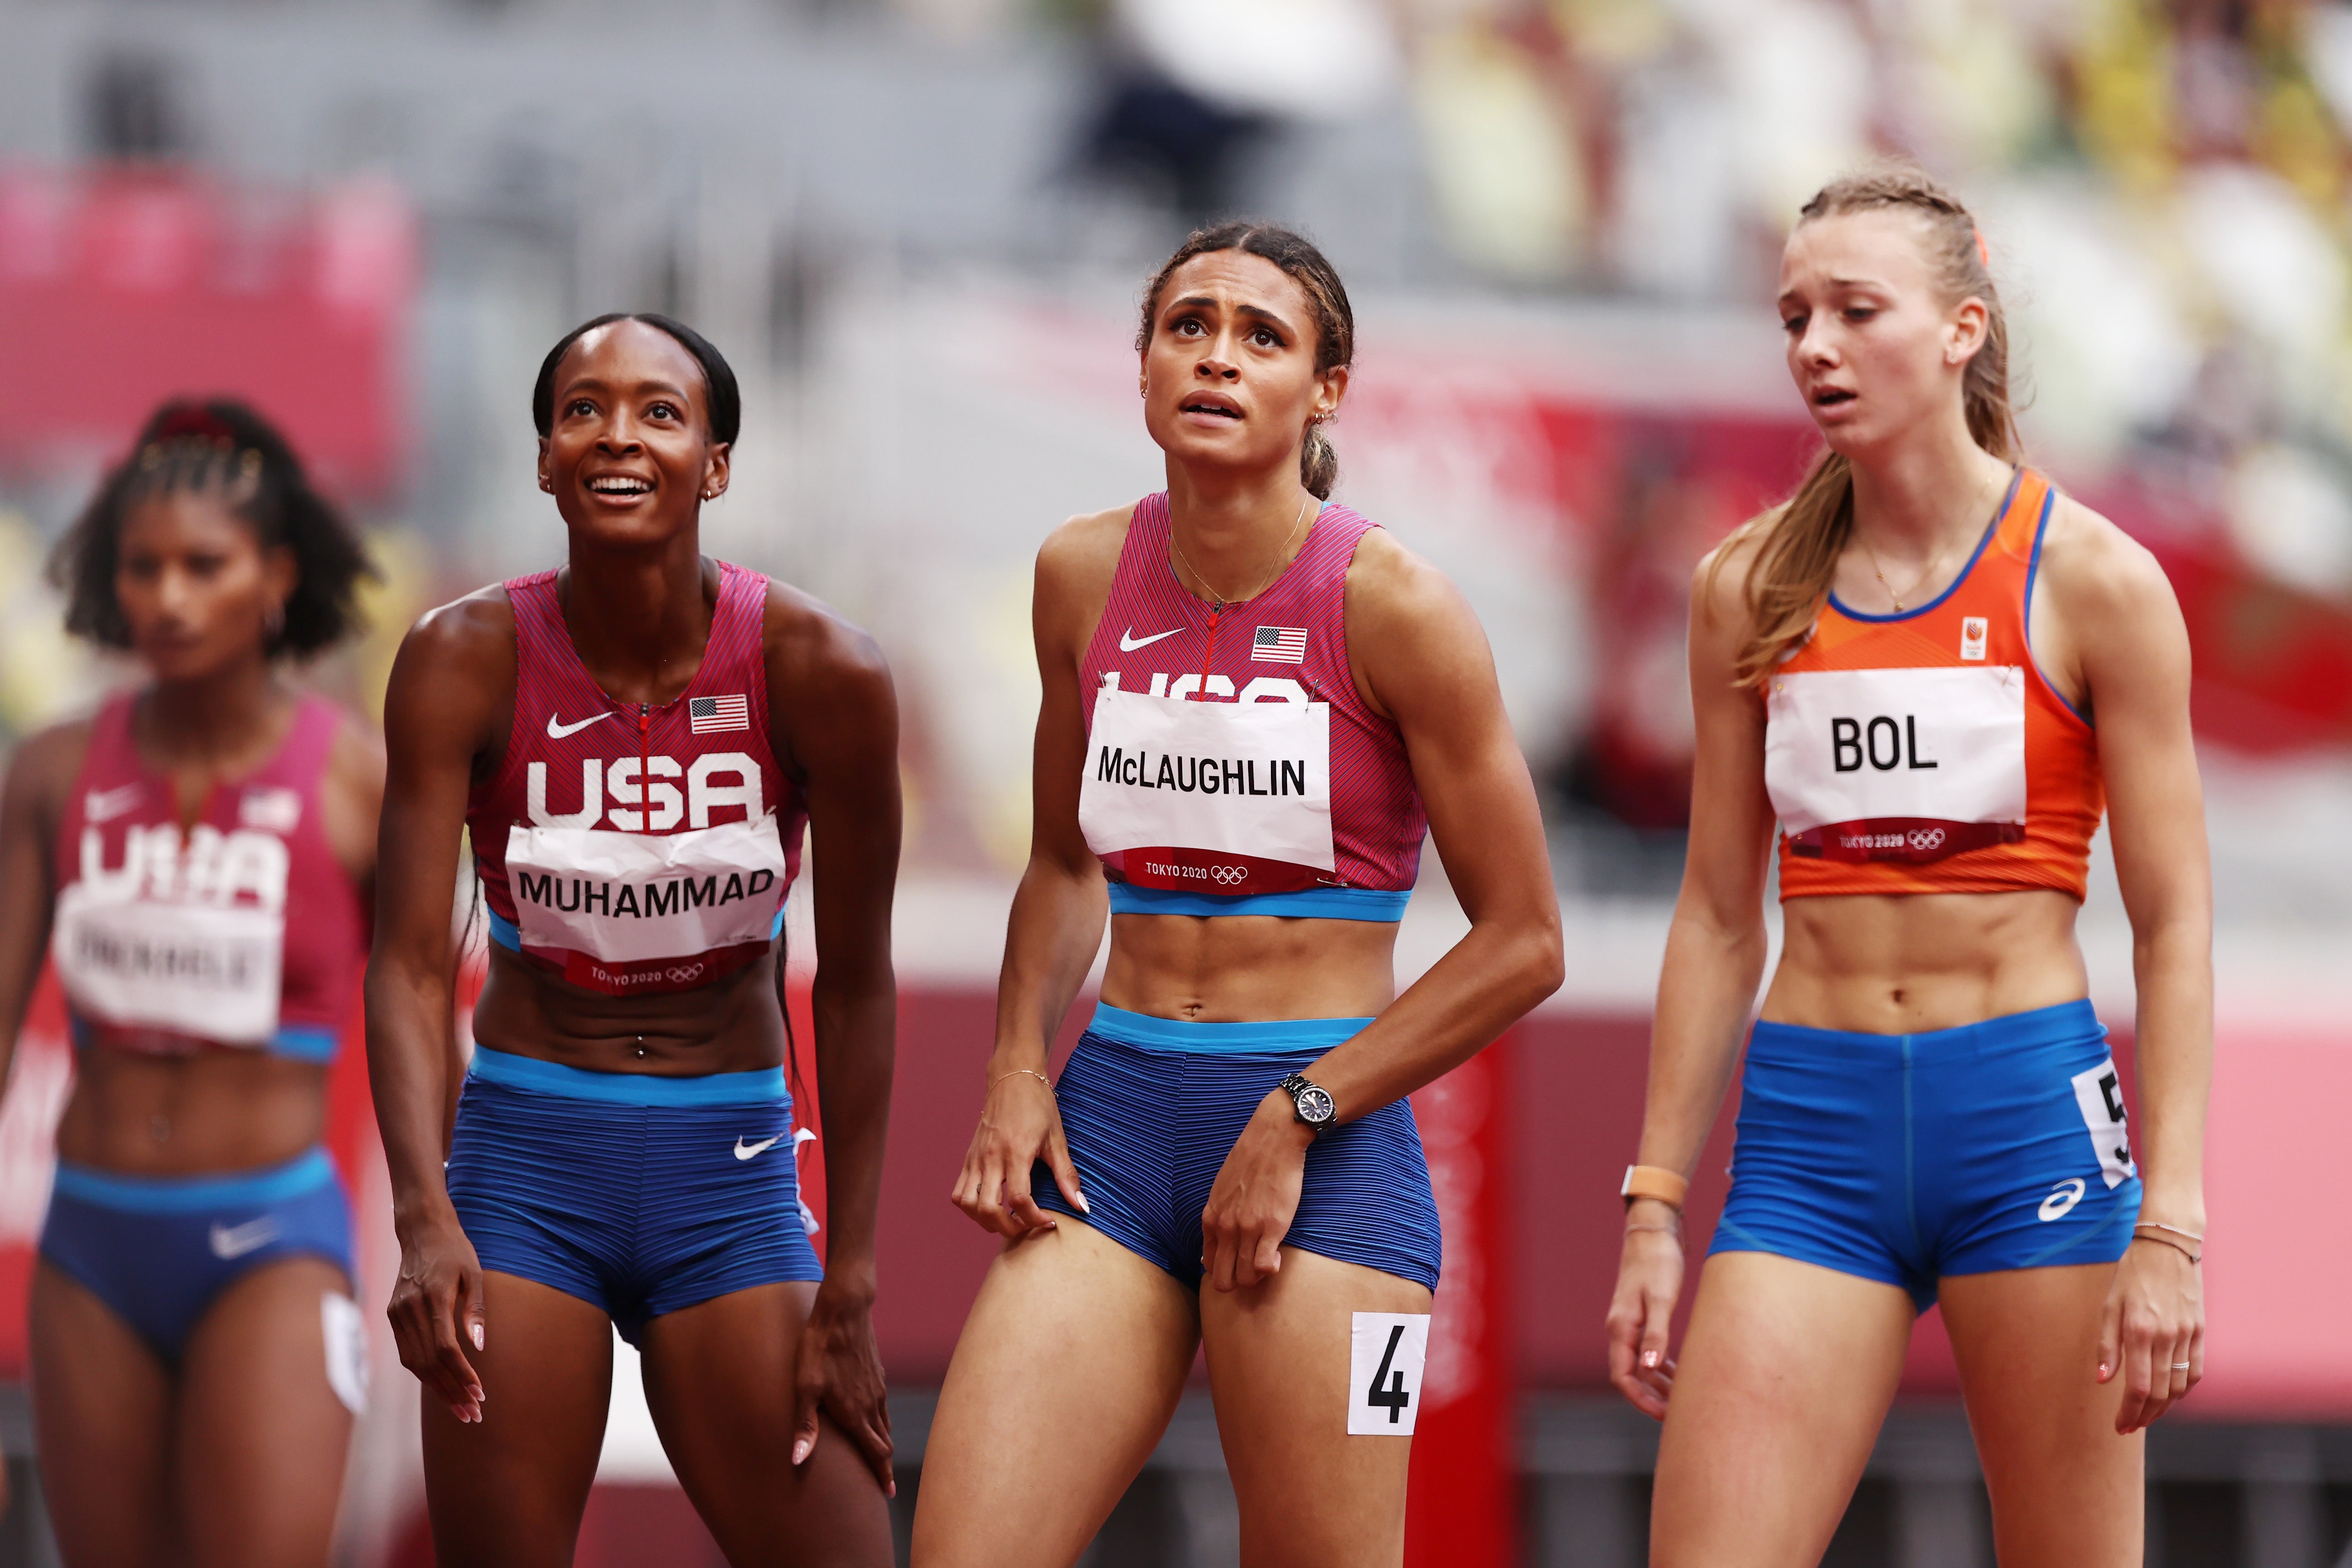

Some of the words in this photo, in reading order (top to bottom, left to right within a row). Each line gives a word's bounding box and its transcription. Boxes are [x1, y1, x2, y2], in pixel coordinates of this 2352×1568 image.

[1832, 715, 1938, 772] BOL
[527, 752, 764, 833] USA
[1098, 746, 1305, 796] McLAUGHLIN
[1874, 833, 1904, 848] 2020
[518, 868, 775, 919] MUHAMMAD
[1145, 862, 1180, 877] TOKYO
[1182, 866, 1207, 879] 2020
[592, 966, 629, 986] TOKYO
[631, 971, 662, 984] 2020
[1368, 1325, 1409, 1424] 4
